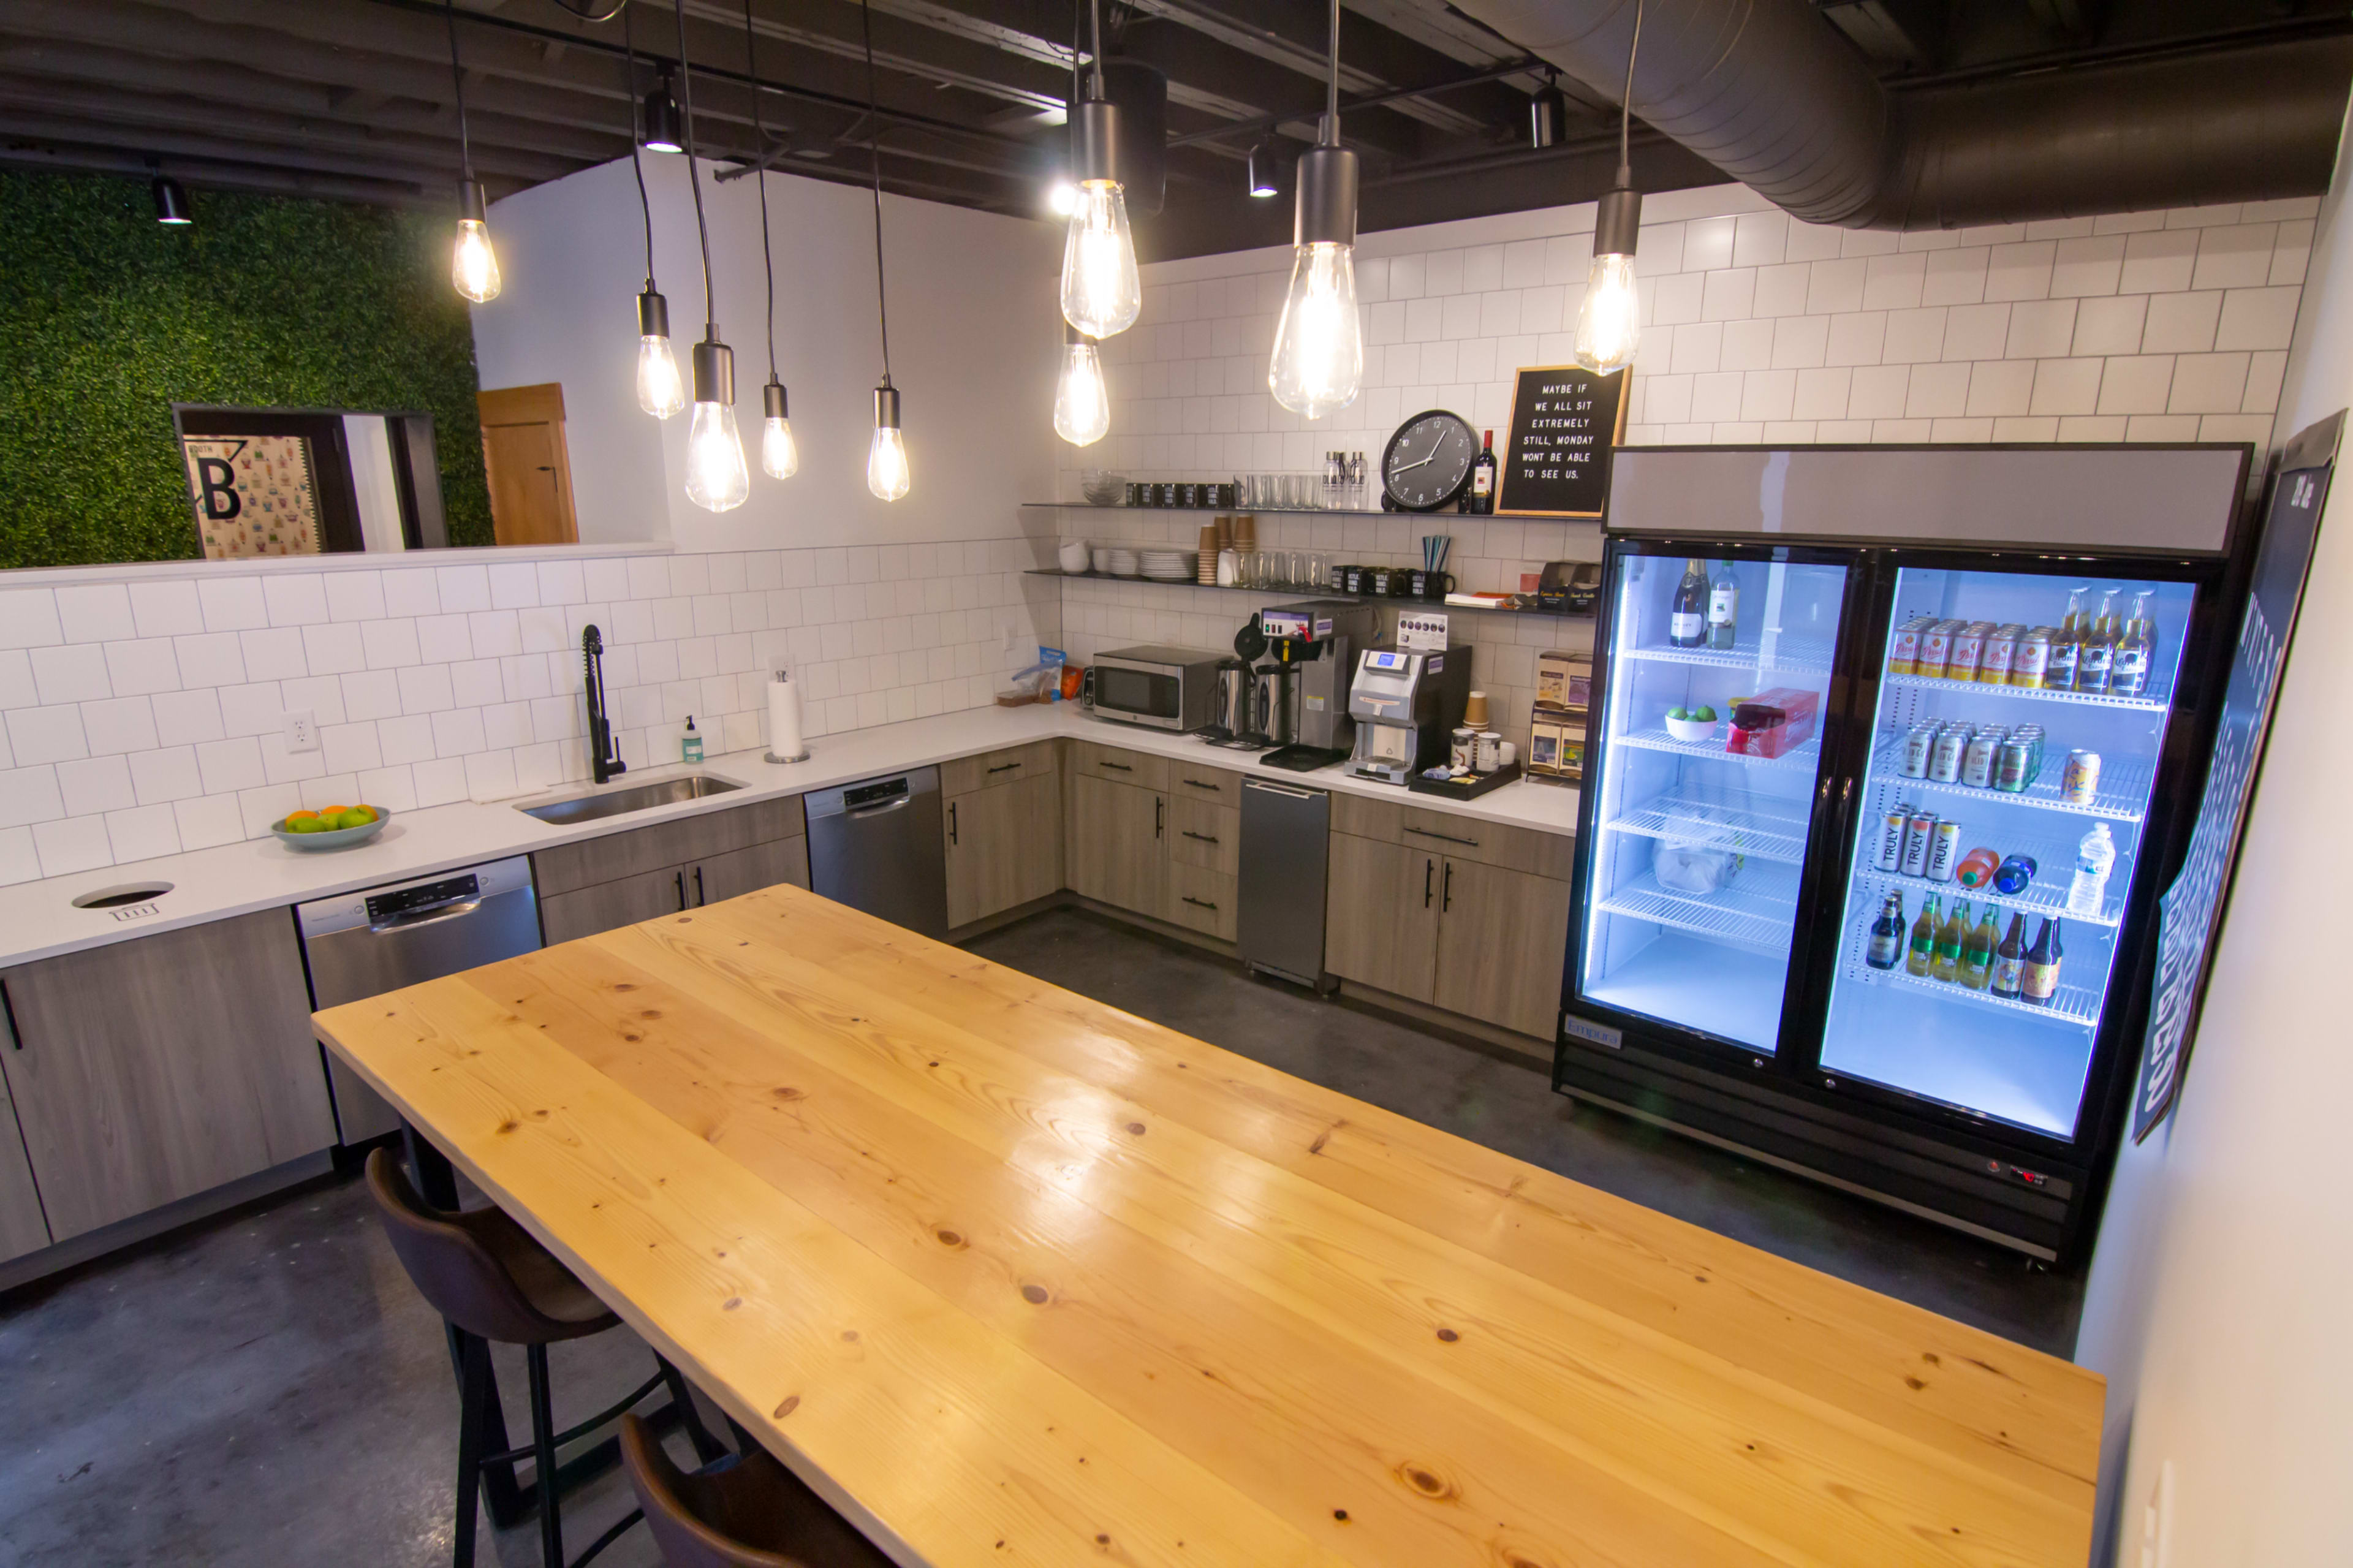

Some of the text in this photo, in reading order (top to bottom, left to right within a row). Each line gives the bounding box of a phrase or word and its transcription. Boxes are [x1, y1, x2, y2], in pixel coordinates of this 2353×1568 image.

[1542, 384, 1588, 395] MAYBE IF
[1535, 401, 1593, 411] WE ALL SIT
[1532, 419, 1590, 428] EXTREMELY
[1523, 436, 1594, 447] STILL, MONDAY
[1523, 453, 1591, 462] WONT BE ABLE
[1524, 469, 1578, 479] TO SEE US.
[197, 458, 241, 520] B
[1883, 827, 1898, 861] TRULY
[1907, 831, 1923, 865] TRULY
[1933, 835, 1949, 869] TRULY
